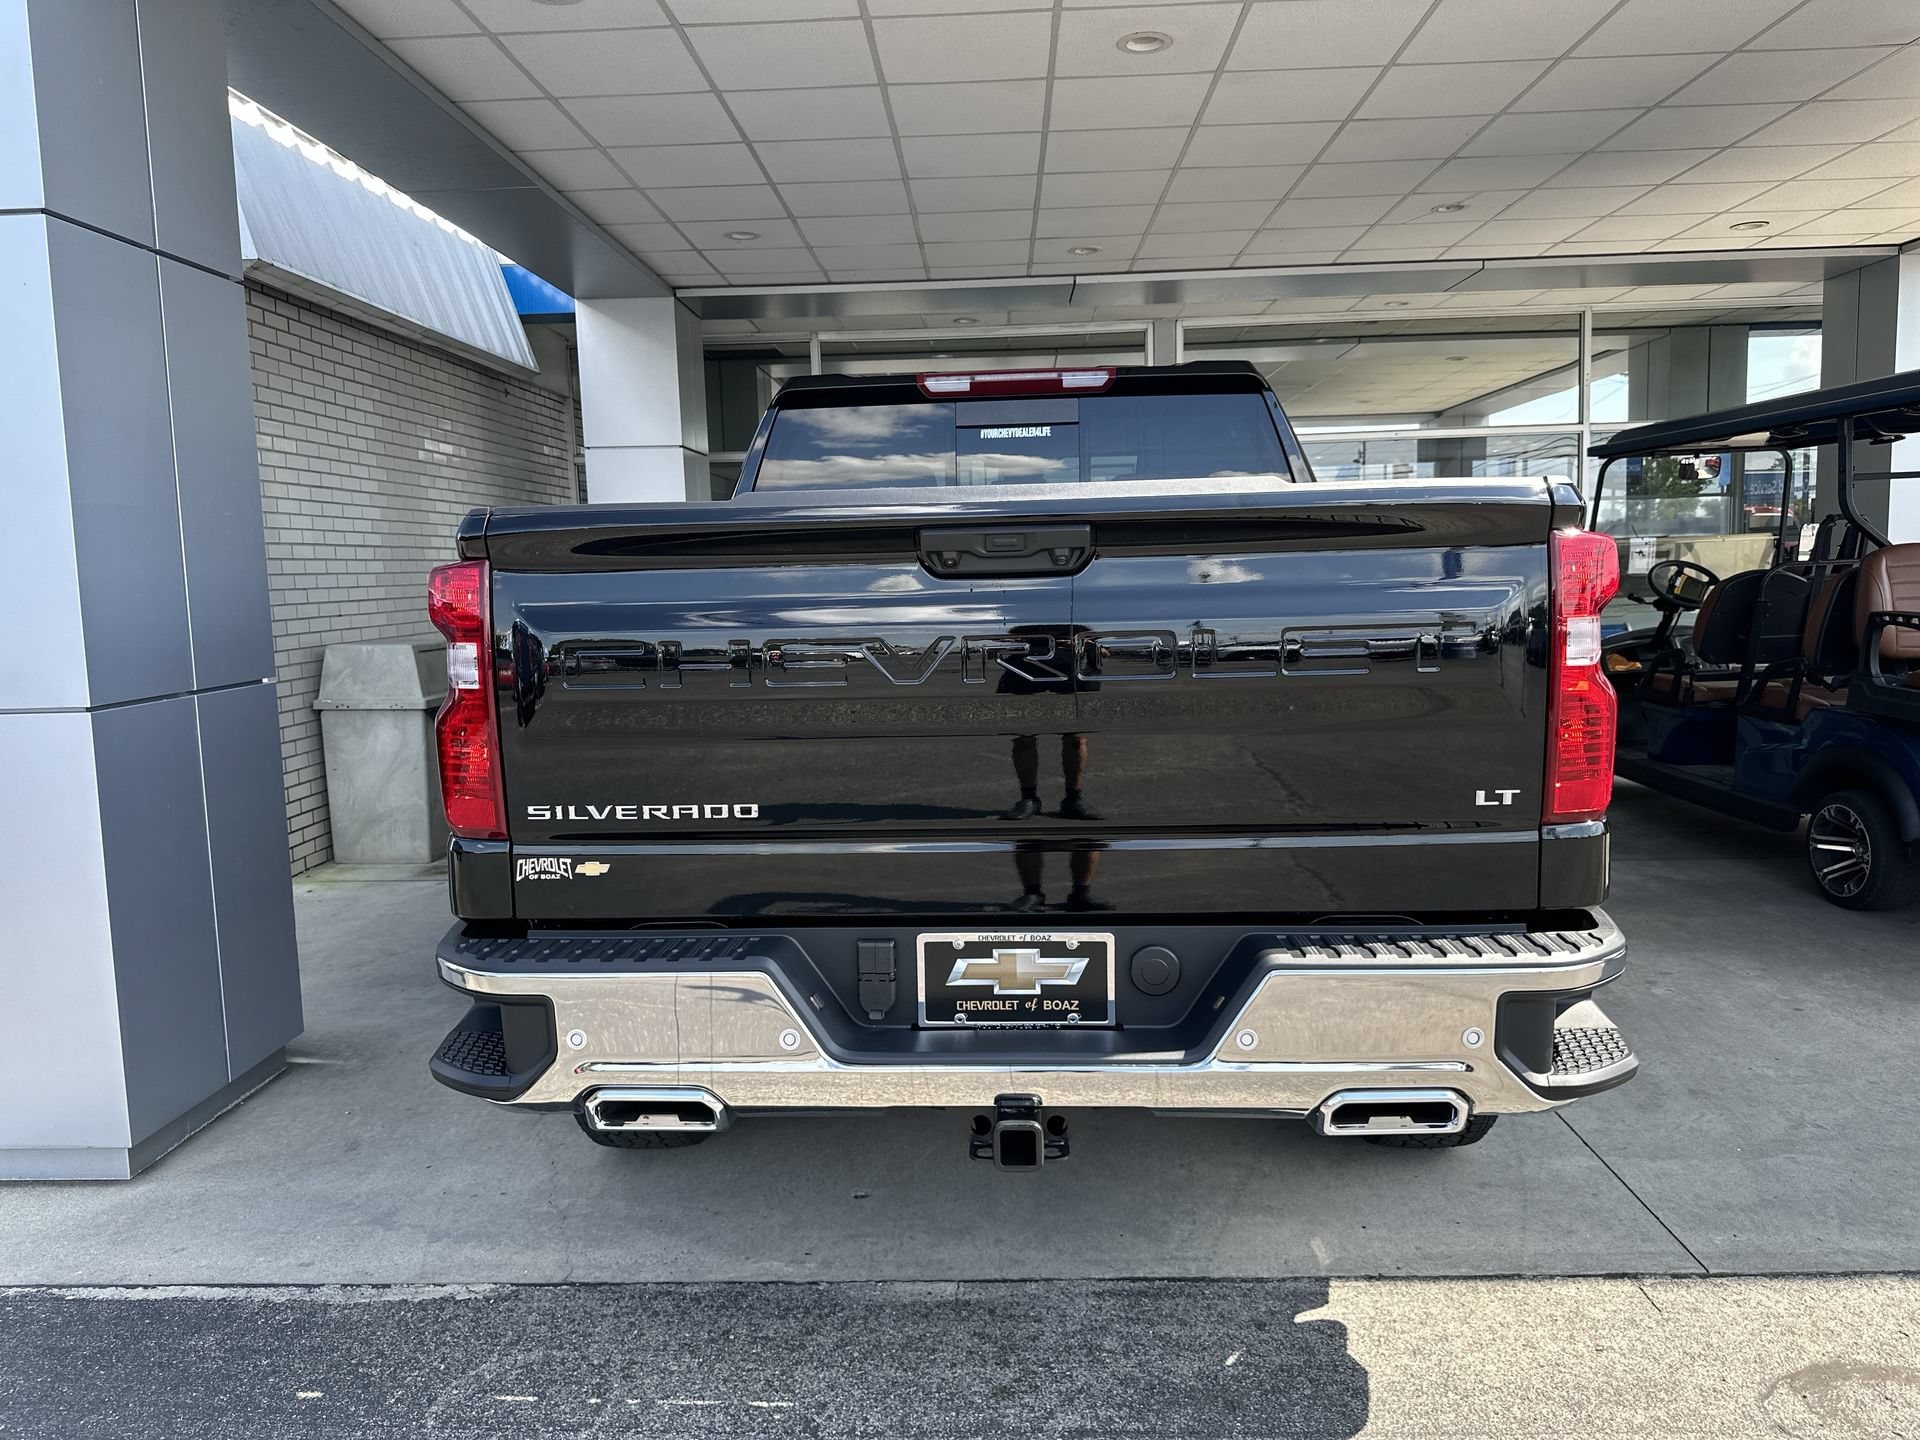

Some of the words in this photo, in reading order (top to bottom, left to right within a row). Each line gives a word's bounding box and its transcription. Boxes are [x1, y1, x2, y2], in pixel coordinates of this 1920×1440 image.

[560, 621, 1477, 690] CHEVROLET
[1475, 789, 1521, 806] LT
[526, 803, 760, 820] SILVERADO
[516, 857, 573, 882] CHEVROLET
[977, 934, 1016, 942] CHEVROLET
[1029, 934, 1052, 942] BOAZ
[956, 1000, 1020, 1011] CHEVROLET
[1024, 998, 1039, 1012] of
[1043, 1000, 1080, 1011] BOAZ
